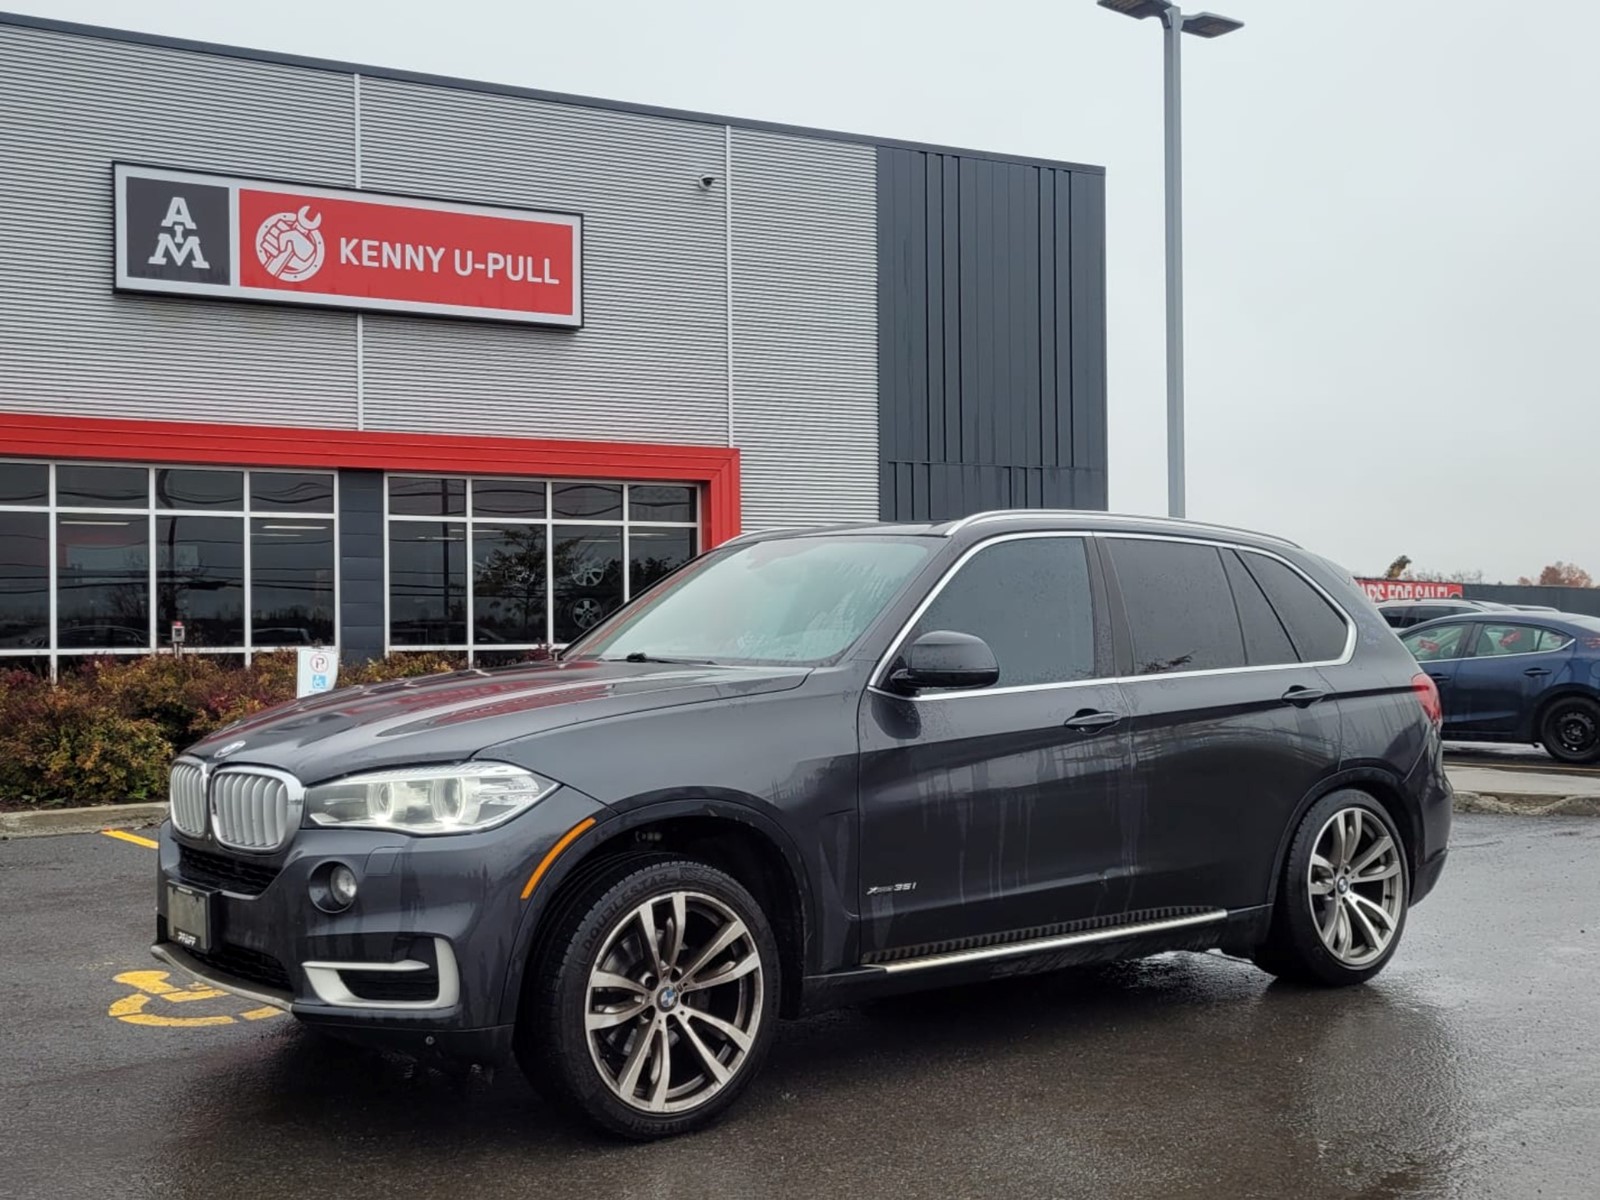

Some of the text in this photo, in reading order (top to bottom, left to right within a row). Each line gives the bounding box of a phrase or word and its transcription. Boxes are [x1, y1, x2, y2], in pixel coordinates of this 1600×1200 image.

[339, 237, 560, 285] KENNY U-PULL
[1361, 582, 1386, 600] RS
[1388, 583, 1413, 599] FOR
